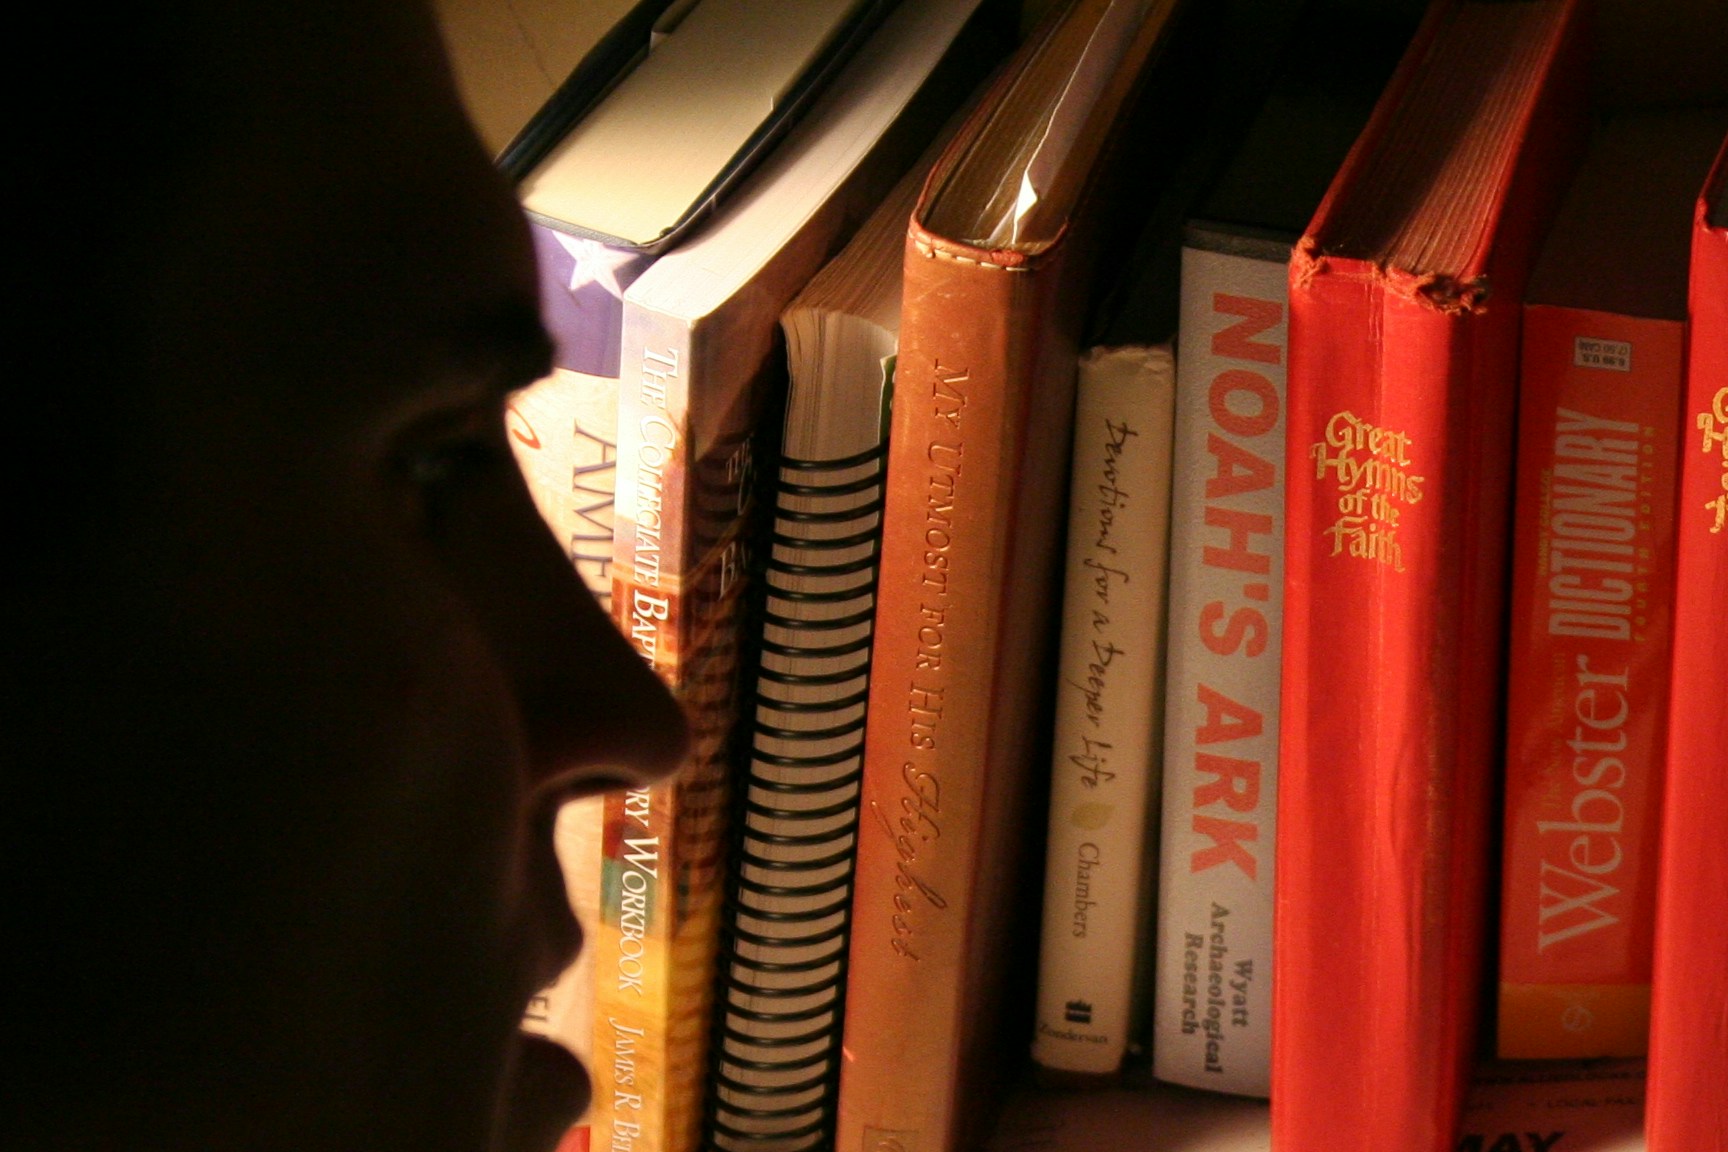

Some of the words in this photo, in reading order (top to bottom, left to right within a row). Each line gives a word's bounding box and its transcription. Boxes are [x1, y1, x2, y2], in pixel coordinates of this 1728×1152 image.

[642, 347, 679, 409] THE
[931, 358, 970, 429] MY
[1198, 292, 1283, 658] NOAH'S
[1309, 442, 1424, 504] Hymns
[1325, 411, 1412, 466] Great
[572, 418, 617, 596] AME
[921, 440, 964, 596] UTMOST
[1096, 419, 1138, 555] Devotions
[1338, 489, 1370, 514] of
[1371, 494, 1400, 527] the
[1548, 406, 1640, 641] DICTIONARY
[1084, 558, 1129, 604] for
[1323, 516, 1405, 572] Faith
[631, 590, 668, 670] BAPT
[915, 603, 945, 671] FOR
[1092, 608, 1111, 633] a
[908, 681, 945, 750] HIS
[1067, 641, 1124, 738] Deeper
[1069, 736, 1115, 791] Life
[1190, 682, 1264, 880] ARK
[1537, 653, 1630, 955] Webster
[870, 762, 947, 962] Highest
[1072, 842, 1100, 938] Chambers
[618, 836, 660, 996] WORKBOOK
[1181, 931, 1204, 1034] Research
[1202, 901, 1230, 1074] Archaeological
[1229, 959, 1253, 1027] Wyatt
[609, 1016, 644, 1085] JAMES
